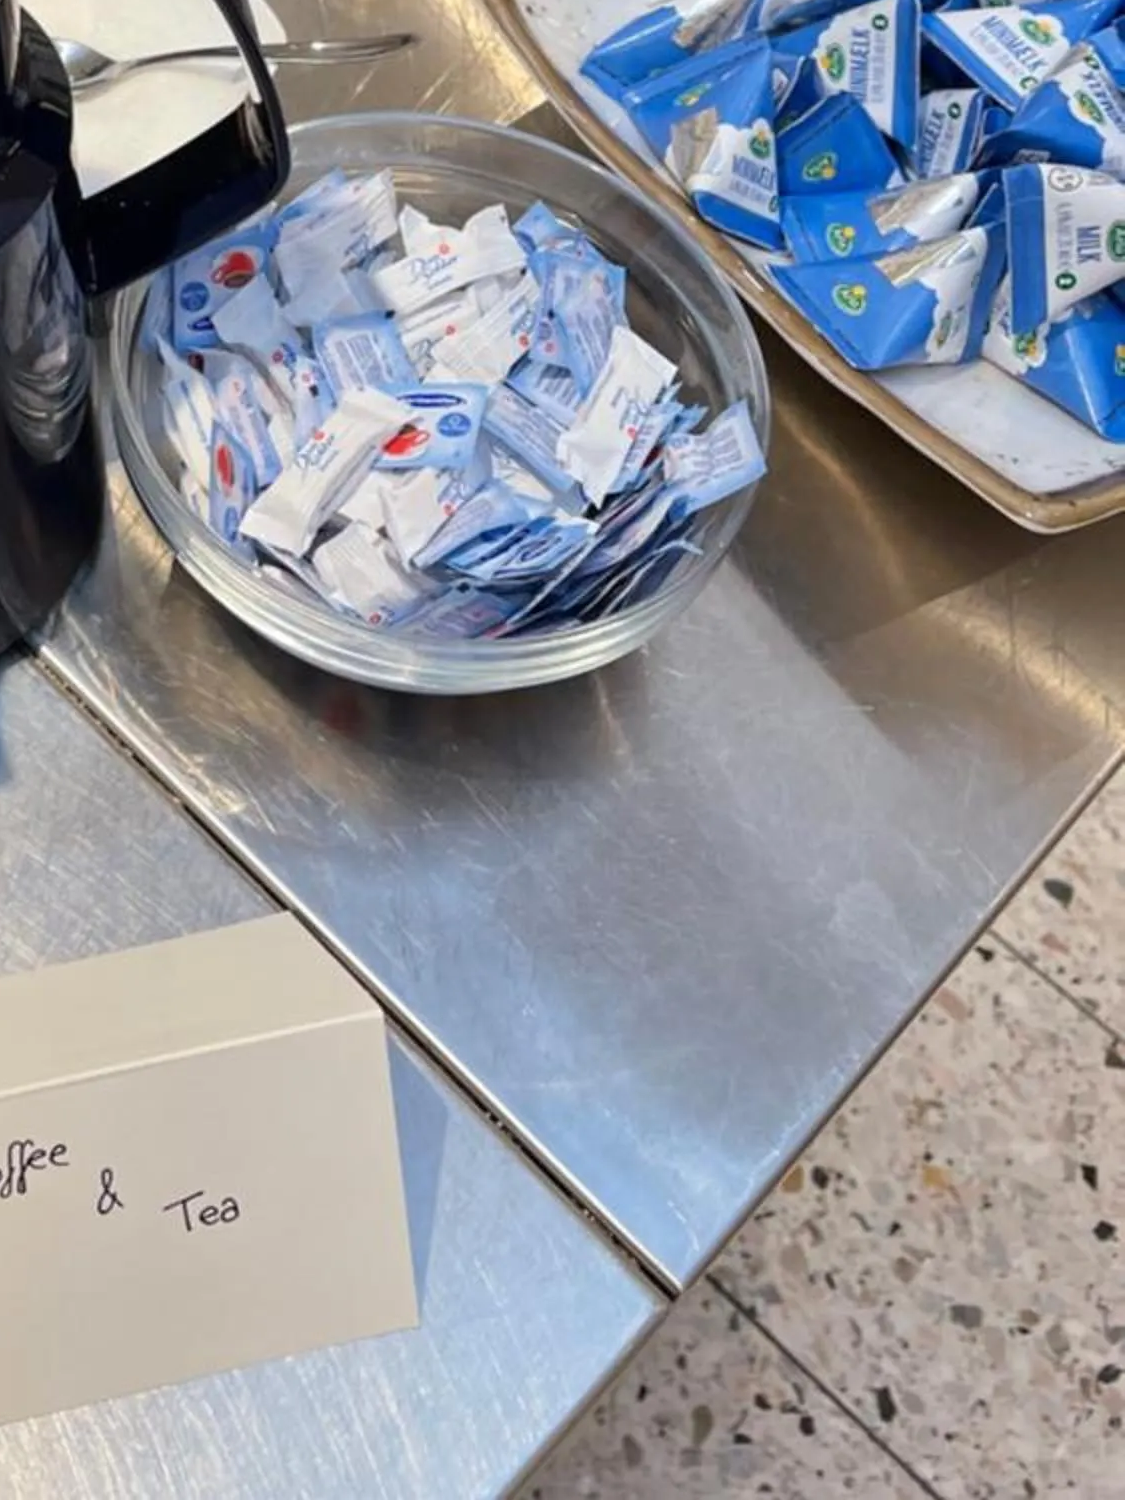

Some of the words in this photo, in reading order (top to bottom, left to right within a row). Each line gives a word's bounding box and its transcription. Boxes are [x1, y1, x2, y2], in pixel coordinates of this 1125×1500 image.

[1077, 225, 1101, 264] MILK
[96, 1167, 124, 1215] &
[163, 1191, 241, 1232] Tea
